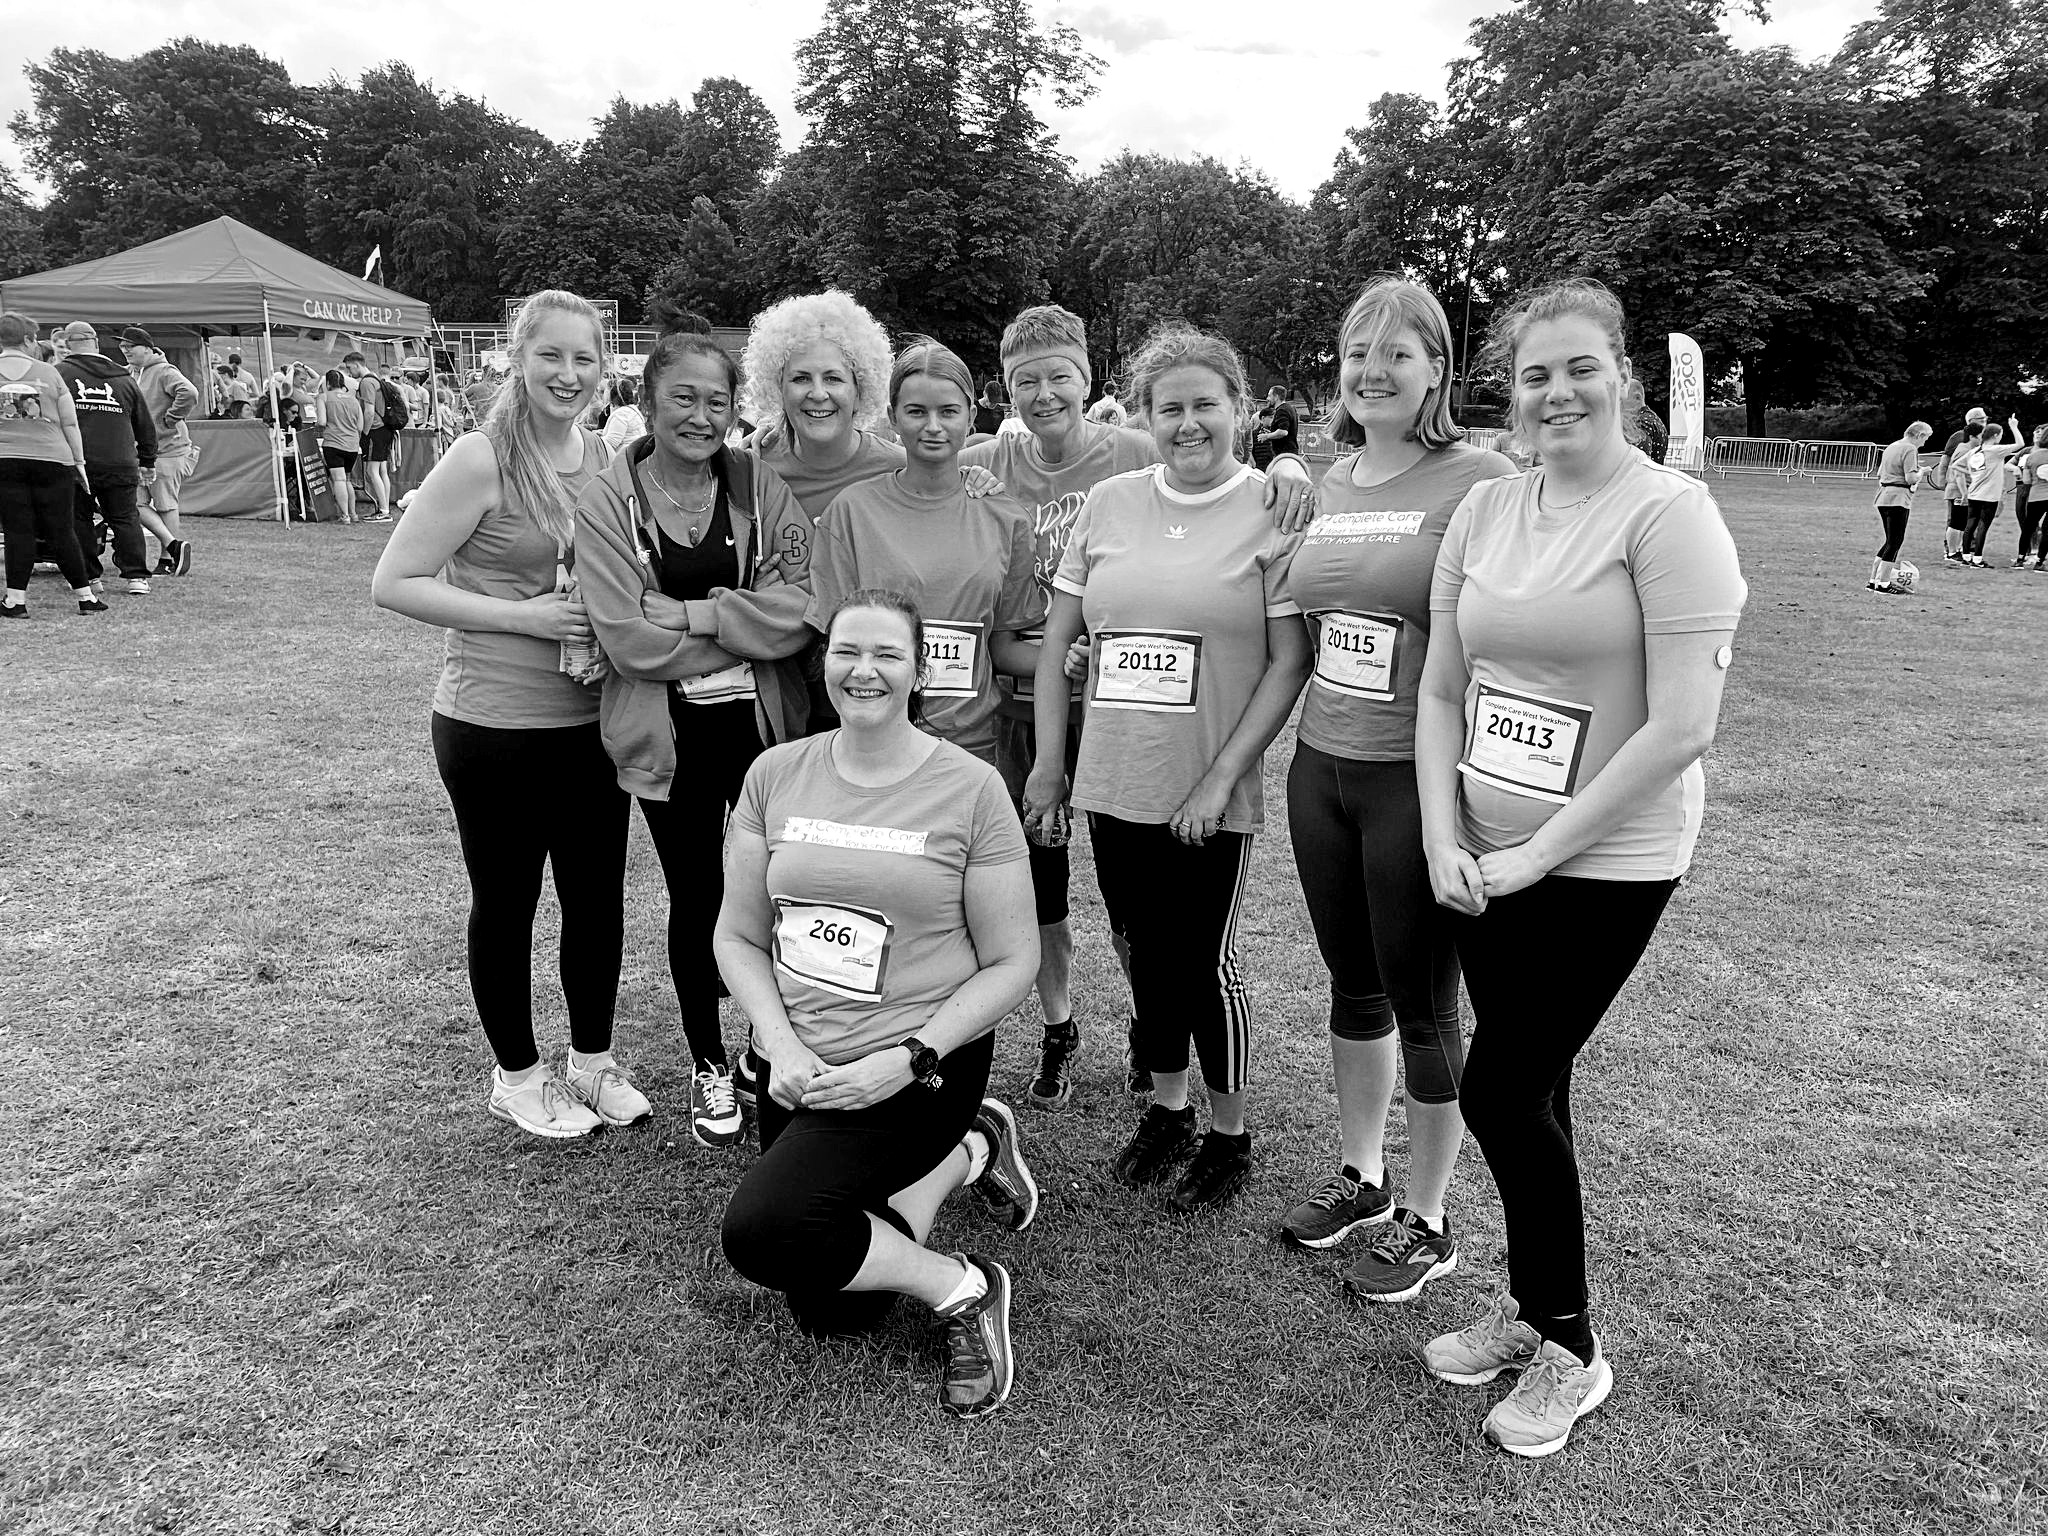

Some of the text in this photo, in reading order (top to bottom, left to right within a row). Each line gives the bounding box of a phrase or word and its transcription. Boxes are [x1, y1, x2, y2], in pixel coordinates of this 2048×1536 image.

[303, 299, 335, 320] CAN
[337, 303, 360, 322] WE
[362, 305, 392, 325] HELP
[1332, 512, 1421, 526] Complete Care
[782, 523, 809, 566] 3
[1335, 535, 1366, 545] HOME
[1368, 534, 1401, 544] CARE
[922, 641, 960, 660] 0111
[1327, 626, 1375, 655] 20115
[1118, 651, 1177, 672] 20112
[1485, 699, 1572, 728] Complete Care West Yorkshire
[1487, 713, 1555, 749] 20113
